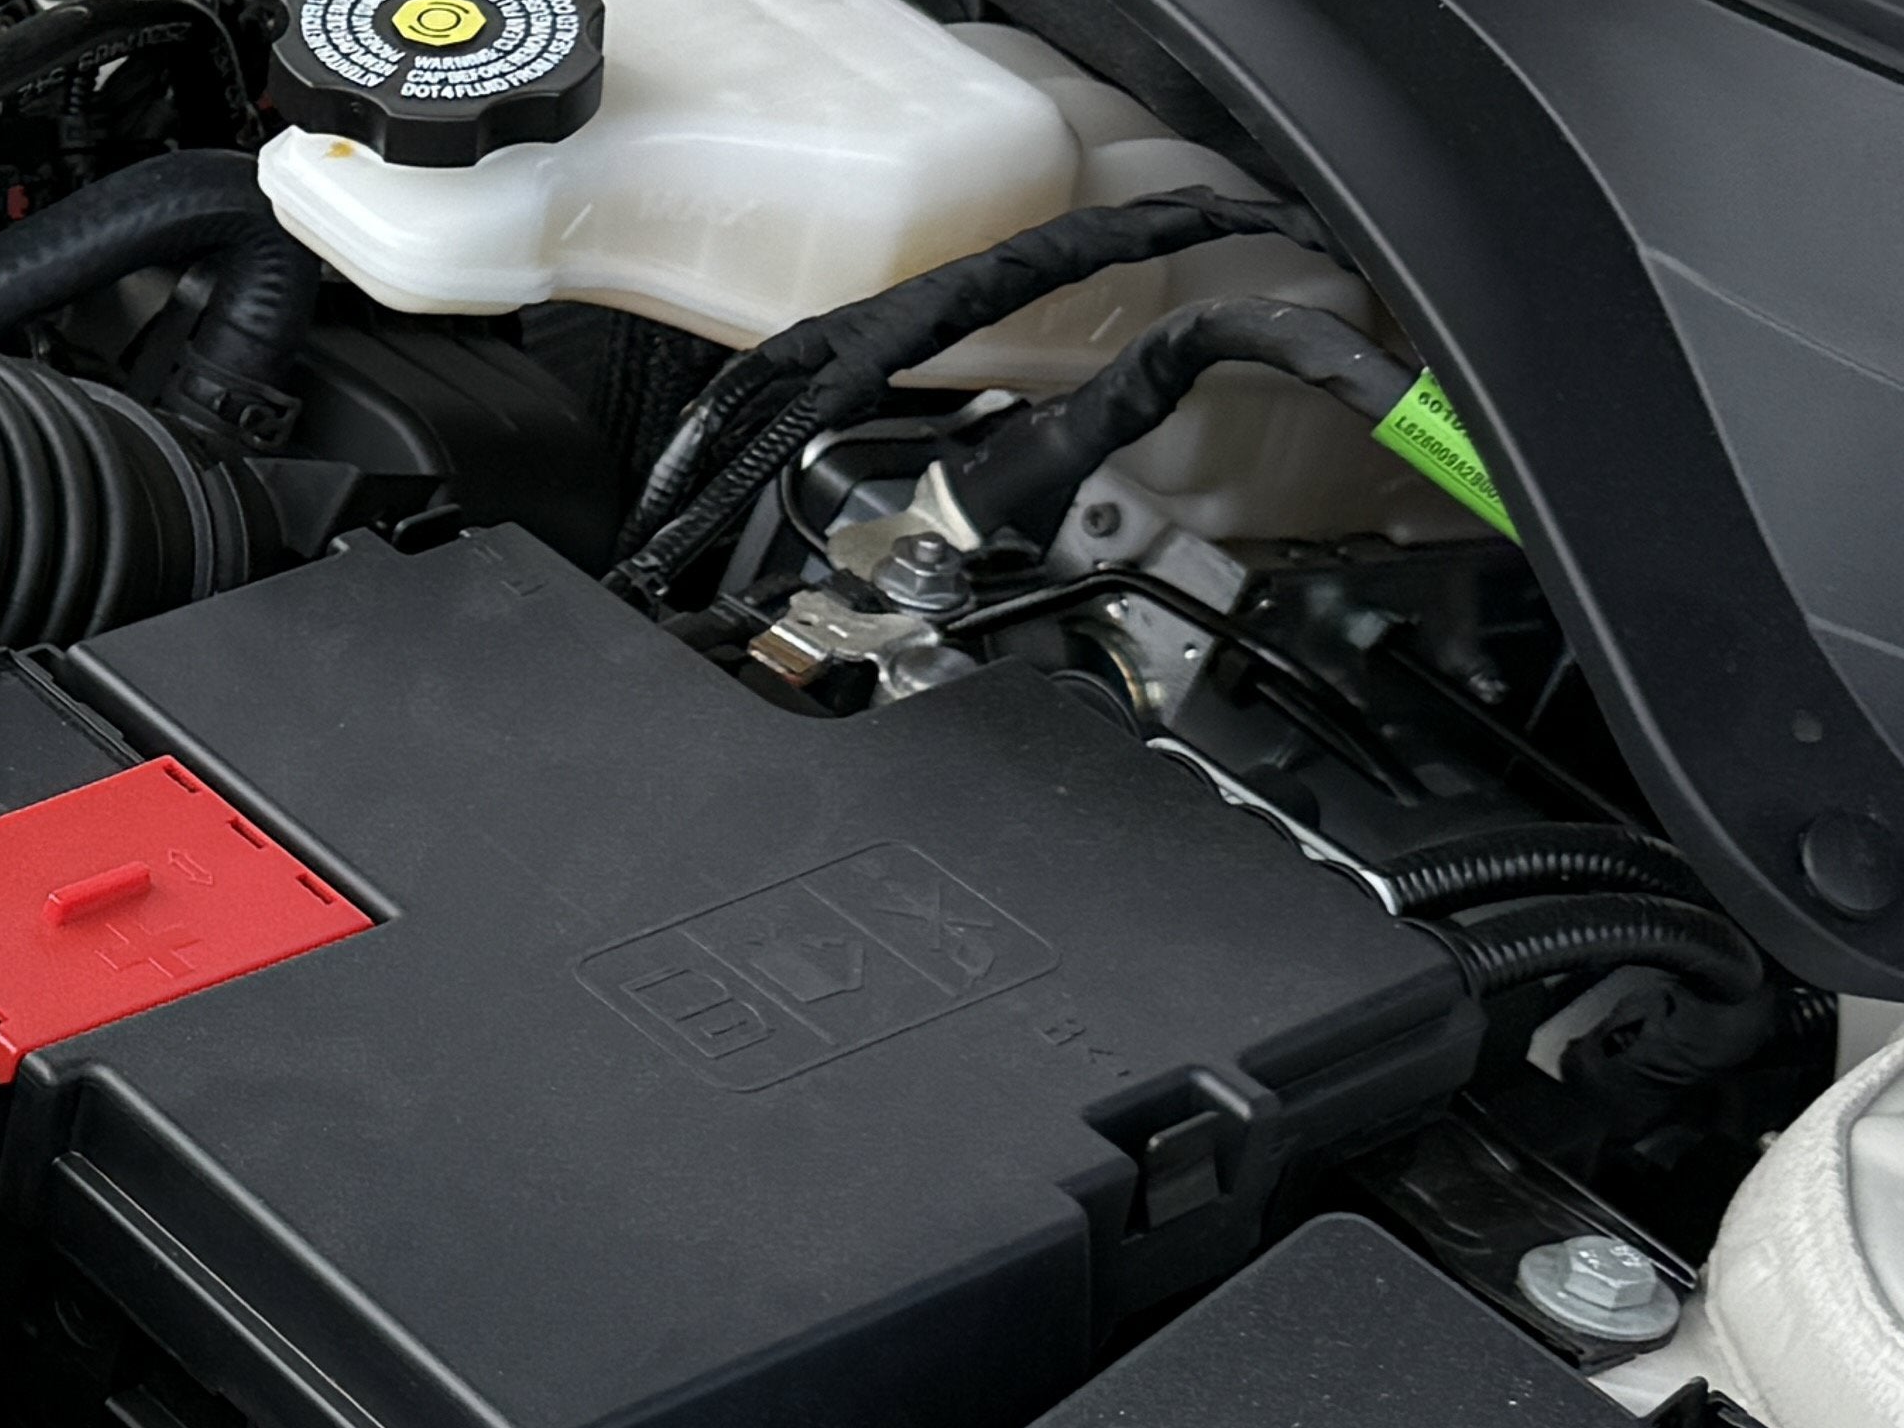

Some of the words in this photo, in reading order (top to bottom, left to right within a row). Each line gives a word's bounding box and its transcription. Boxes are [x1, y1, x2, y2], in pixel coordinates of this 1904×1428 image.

[404, 69, 447, 83] CAP
[398, 82, 440, 98] DOT
[454, 75, 512, 98] FLUID
